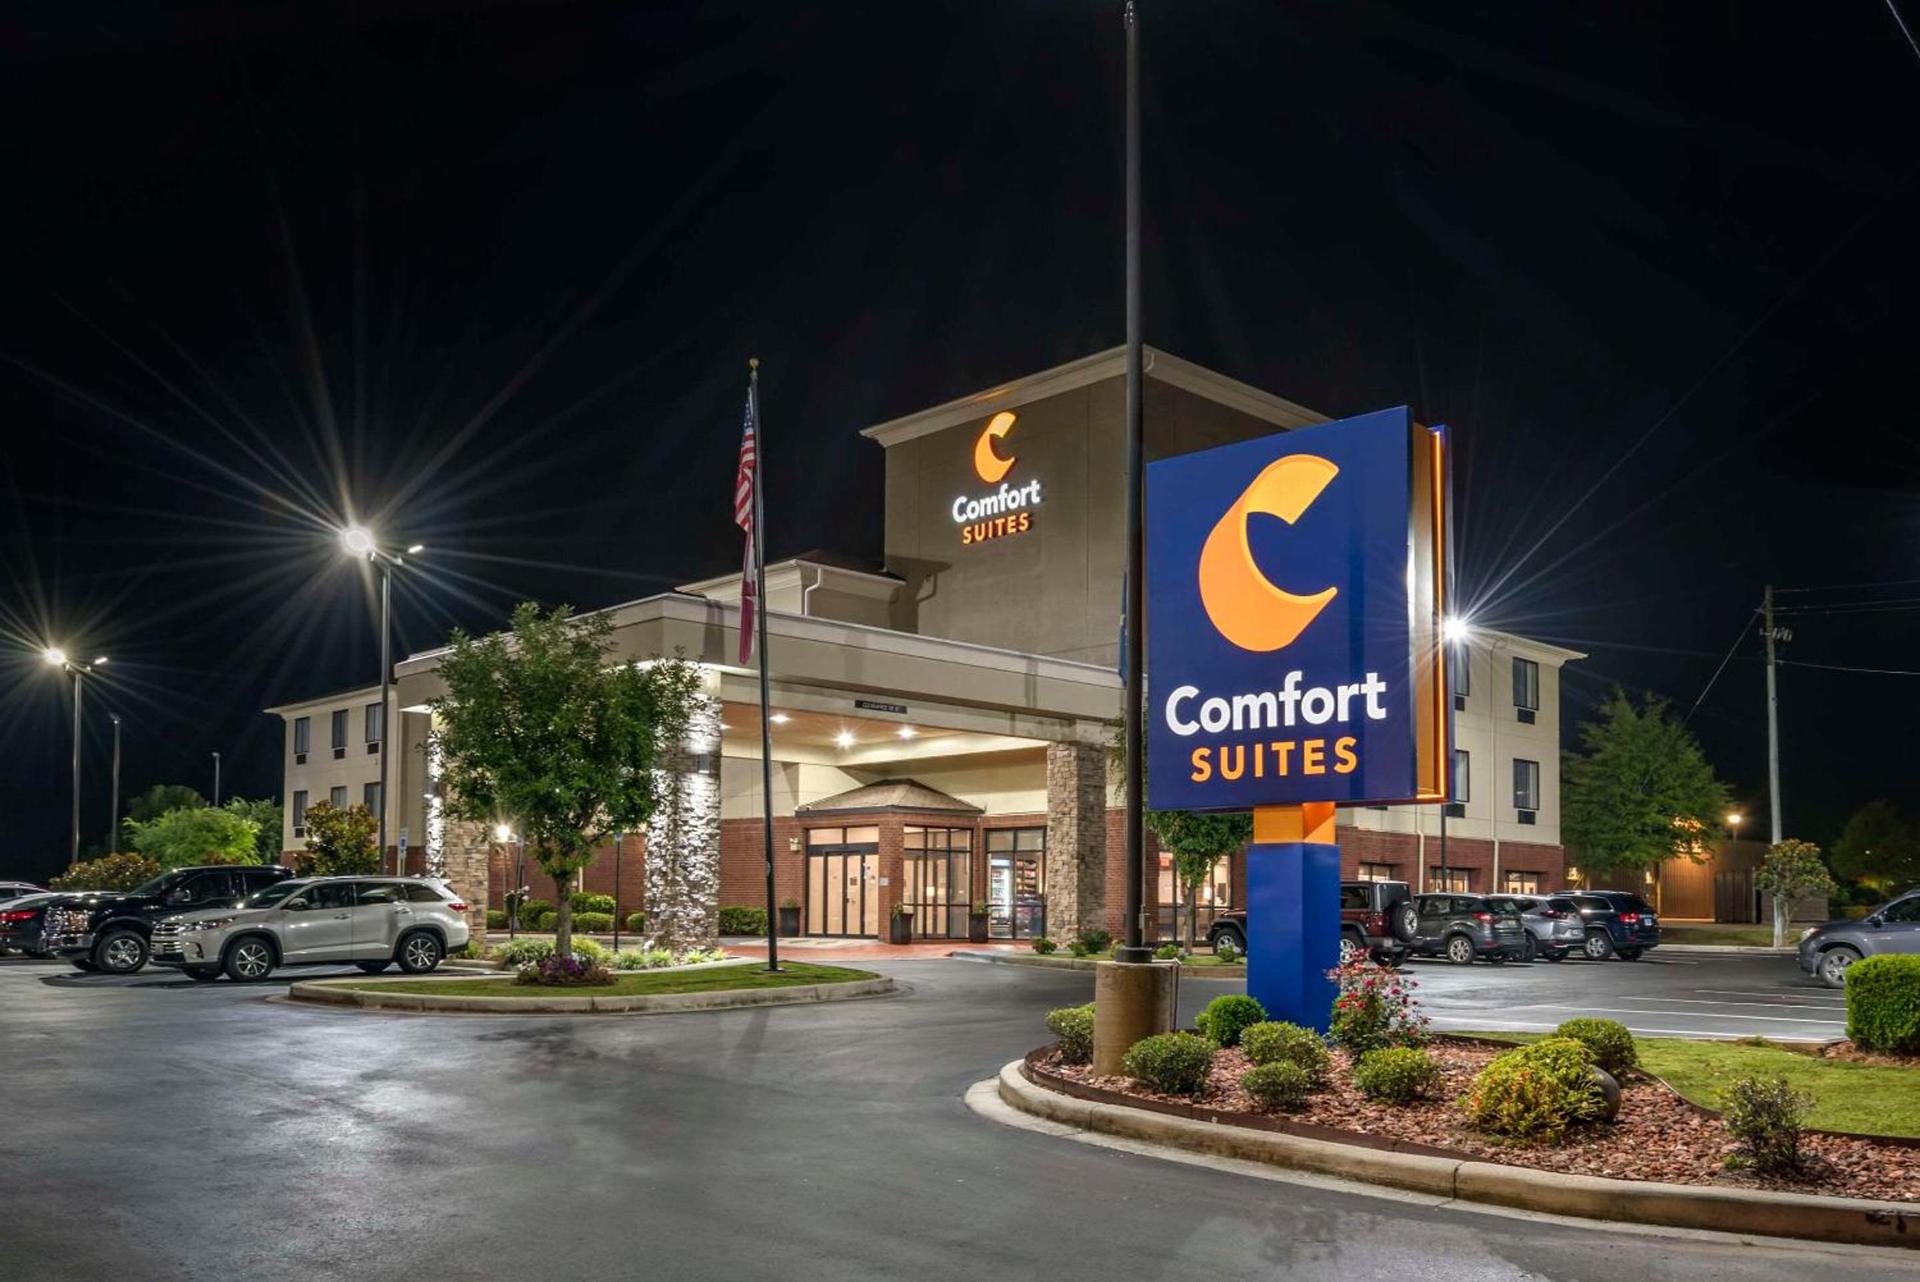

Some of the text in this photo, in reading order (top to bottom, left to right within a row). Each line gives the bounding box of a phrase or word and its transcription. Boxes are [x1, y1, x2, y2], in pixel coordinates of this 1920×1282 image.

[952, 479, 1041, 523] Comfort
[962, 512, 1030, 544] SUITES
[1165, 670, 1387, 736] Comfort
[1191, 736, 1358, 783] SUITES
